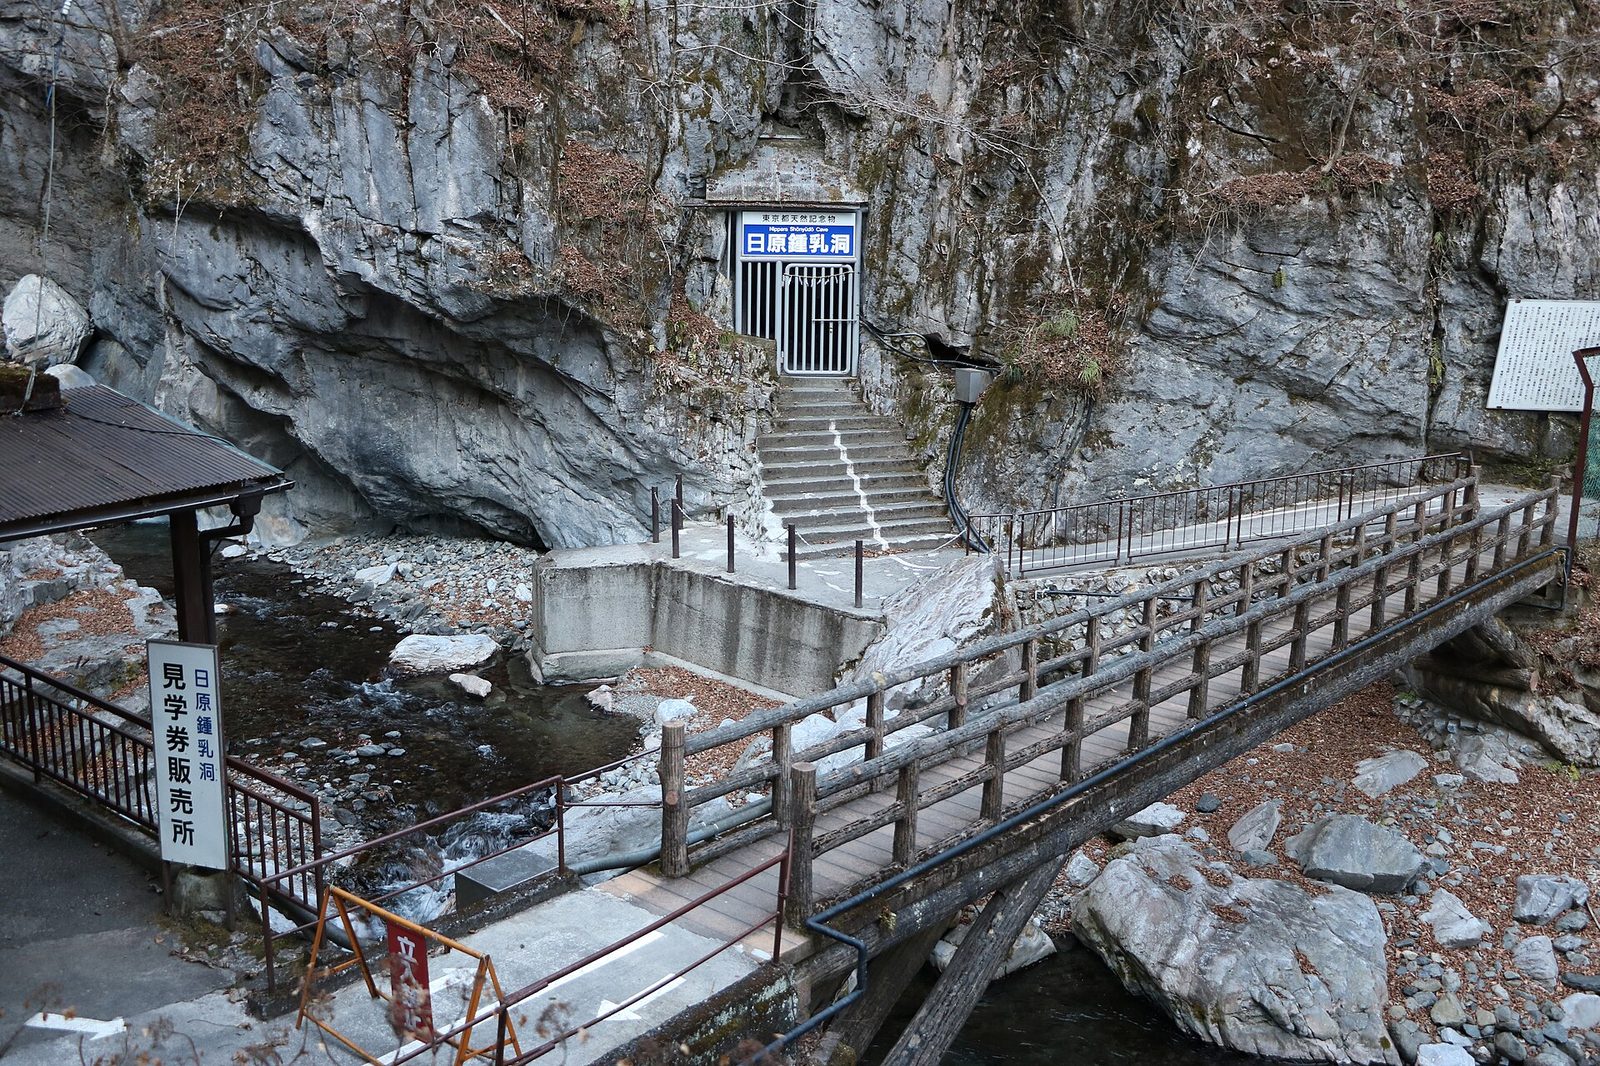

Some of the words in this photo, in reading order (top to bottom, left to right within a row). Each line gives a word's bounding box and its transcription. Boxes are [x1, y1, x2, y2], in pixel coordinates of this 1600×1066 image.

[762, 214, 836, 223] 東京都天然記念物
[163, 663, 195, 846] 見学券販売所
